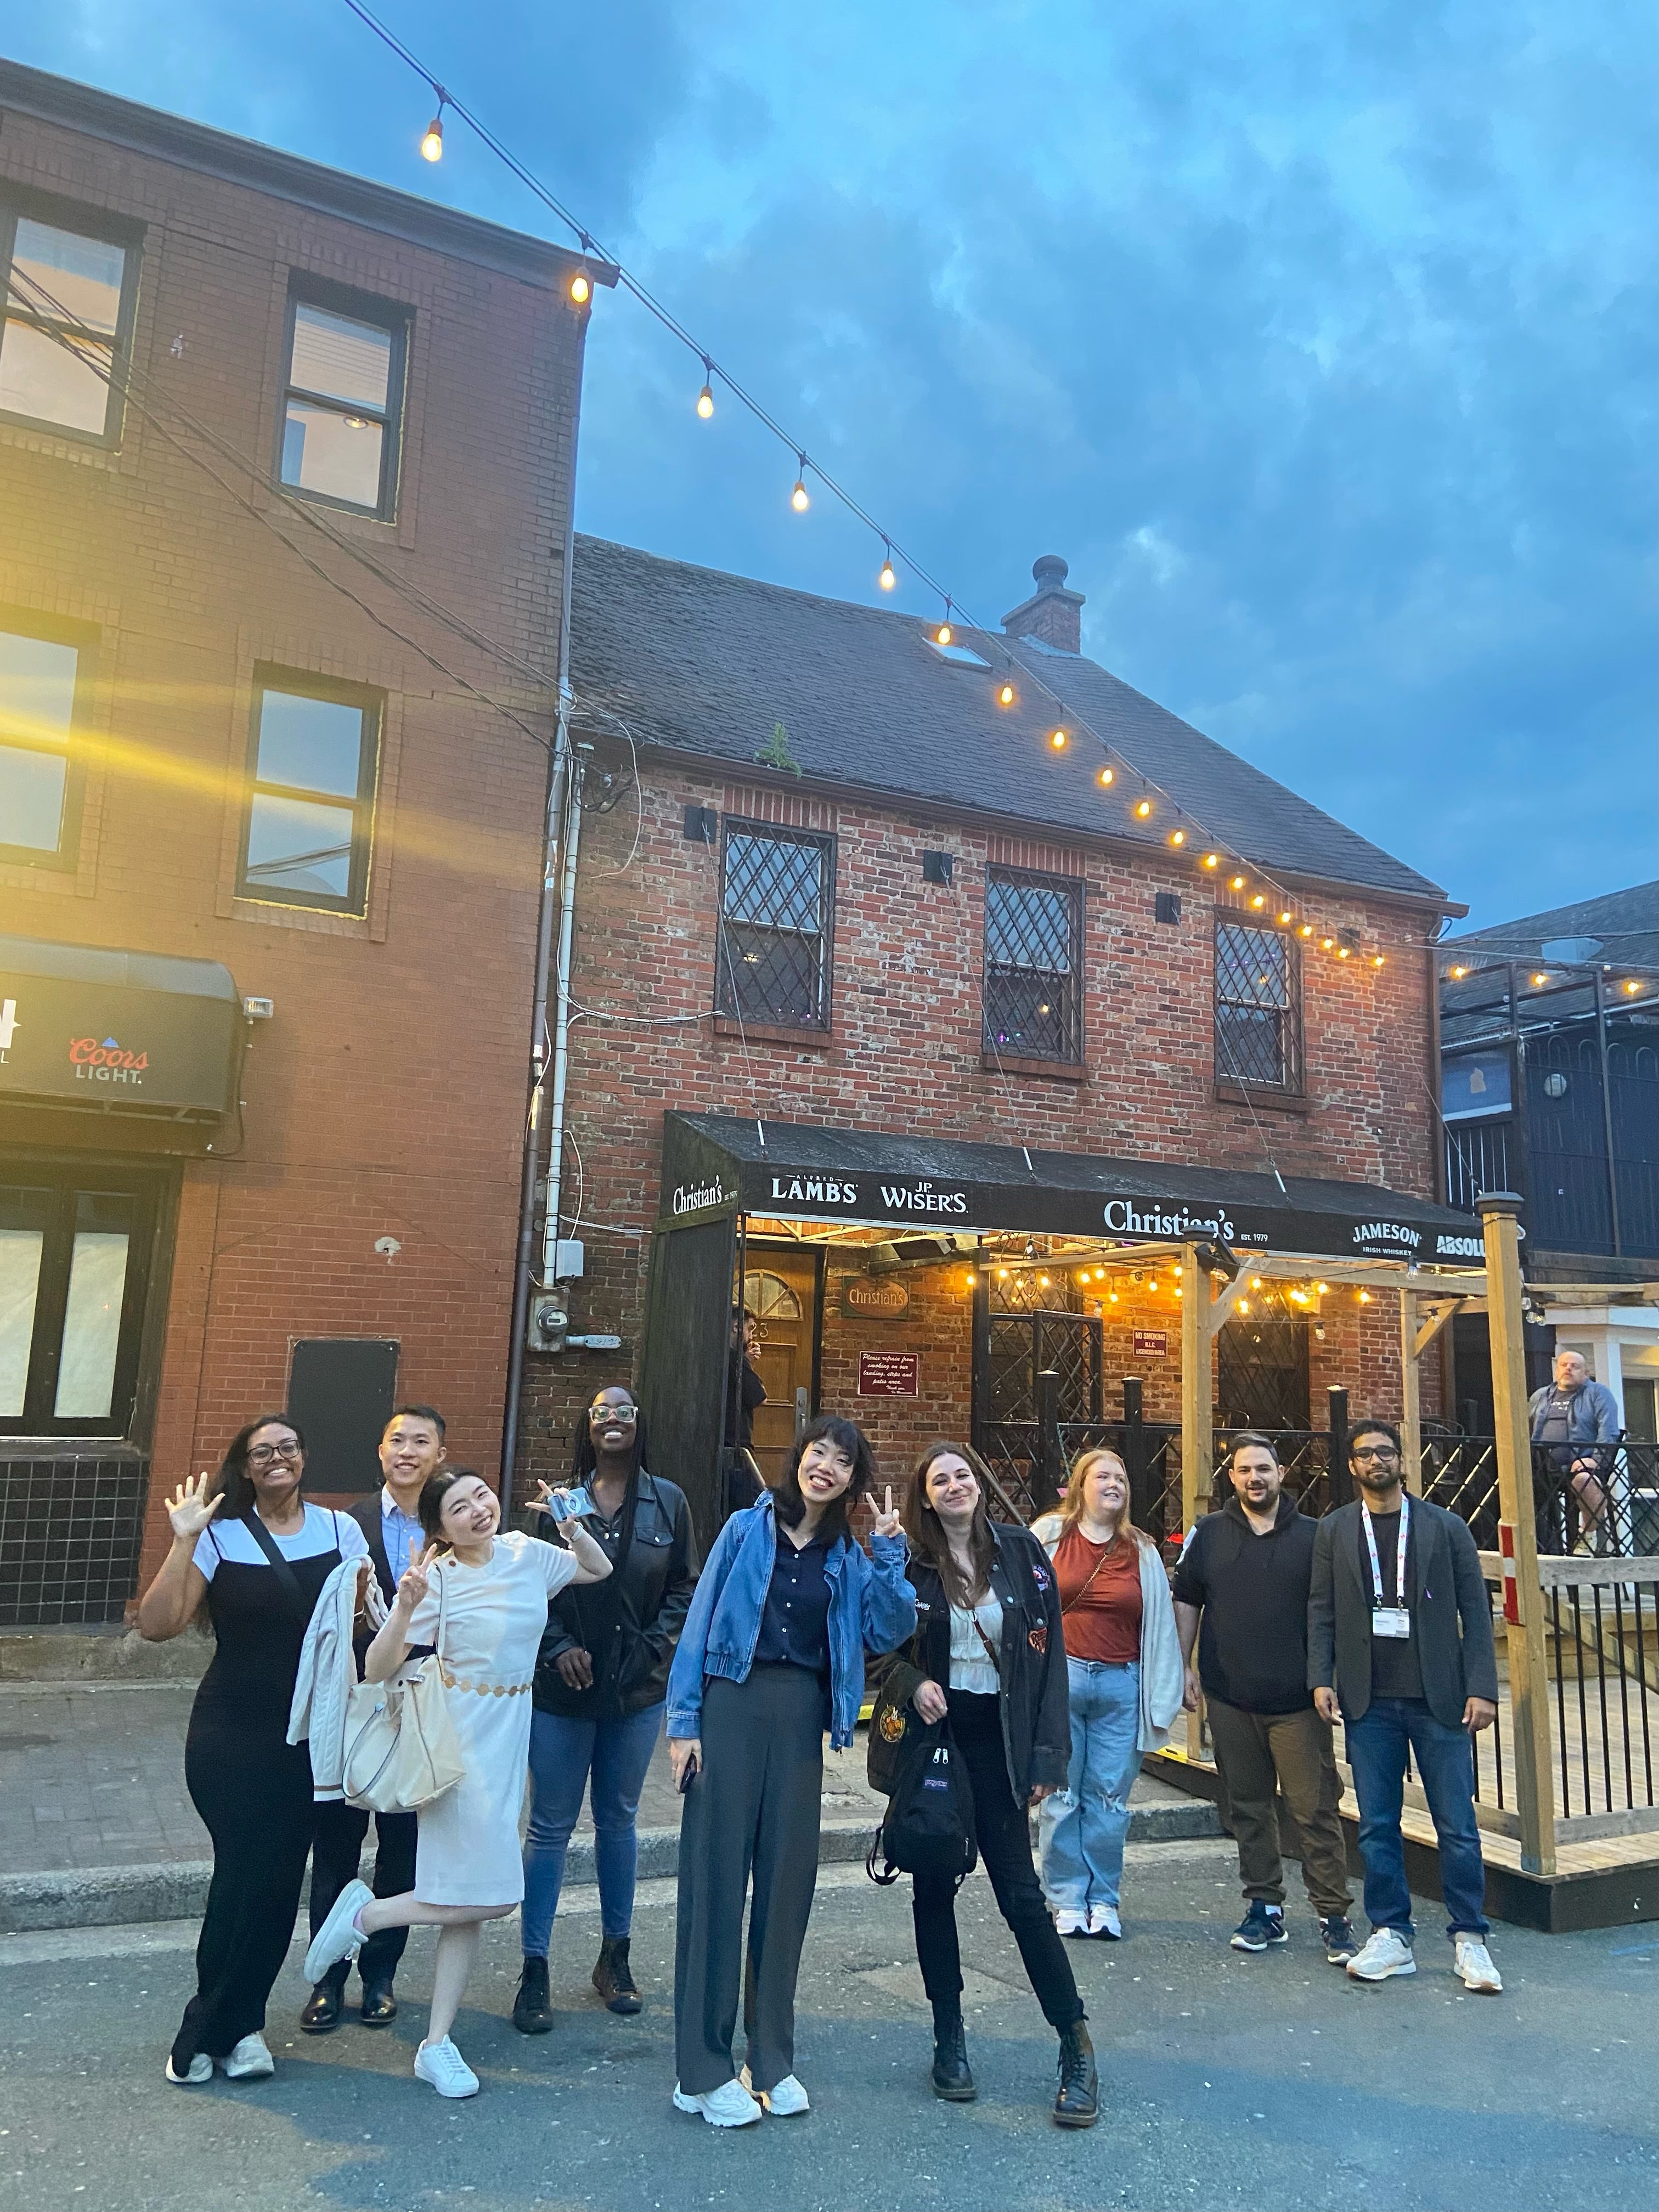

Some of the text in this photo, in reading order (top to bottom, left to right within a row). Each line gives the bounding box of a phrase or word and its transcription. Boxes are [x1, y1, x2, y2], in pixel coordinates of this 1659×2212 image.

[70, 1038, 149, 1069] Coors
[76, 1064, 141, 1084] LIGHT
[673, 1175, 722, 1215] Christian's
[771, 1178, 857, 1204] LAMB'S
[915, 1182, 933, 1193] J.P.
[880, 1186, 966, 1214] WISER'S
[1253, 1233, 1268, 1242] 1979
[1353, 1223, 1420, 1248] JAMESON
[1382, 1248, 1412, 1256] WHISKEY
[849, 1288, 904, 1305] Christian's
[1143, 1332, 1166, 1341] SMOKING
